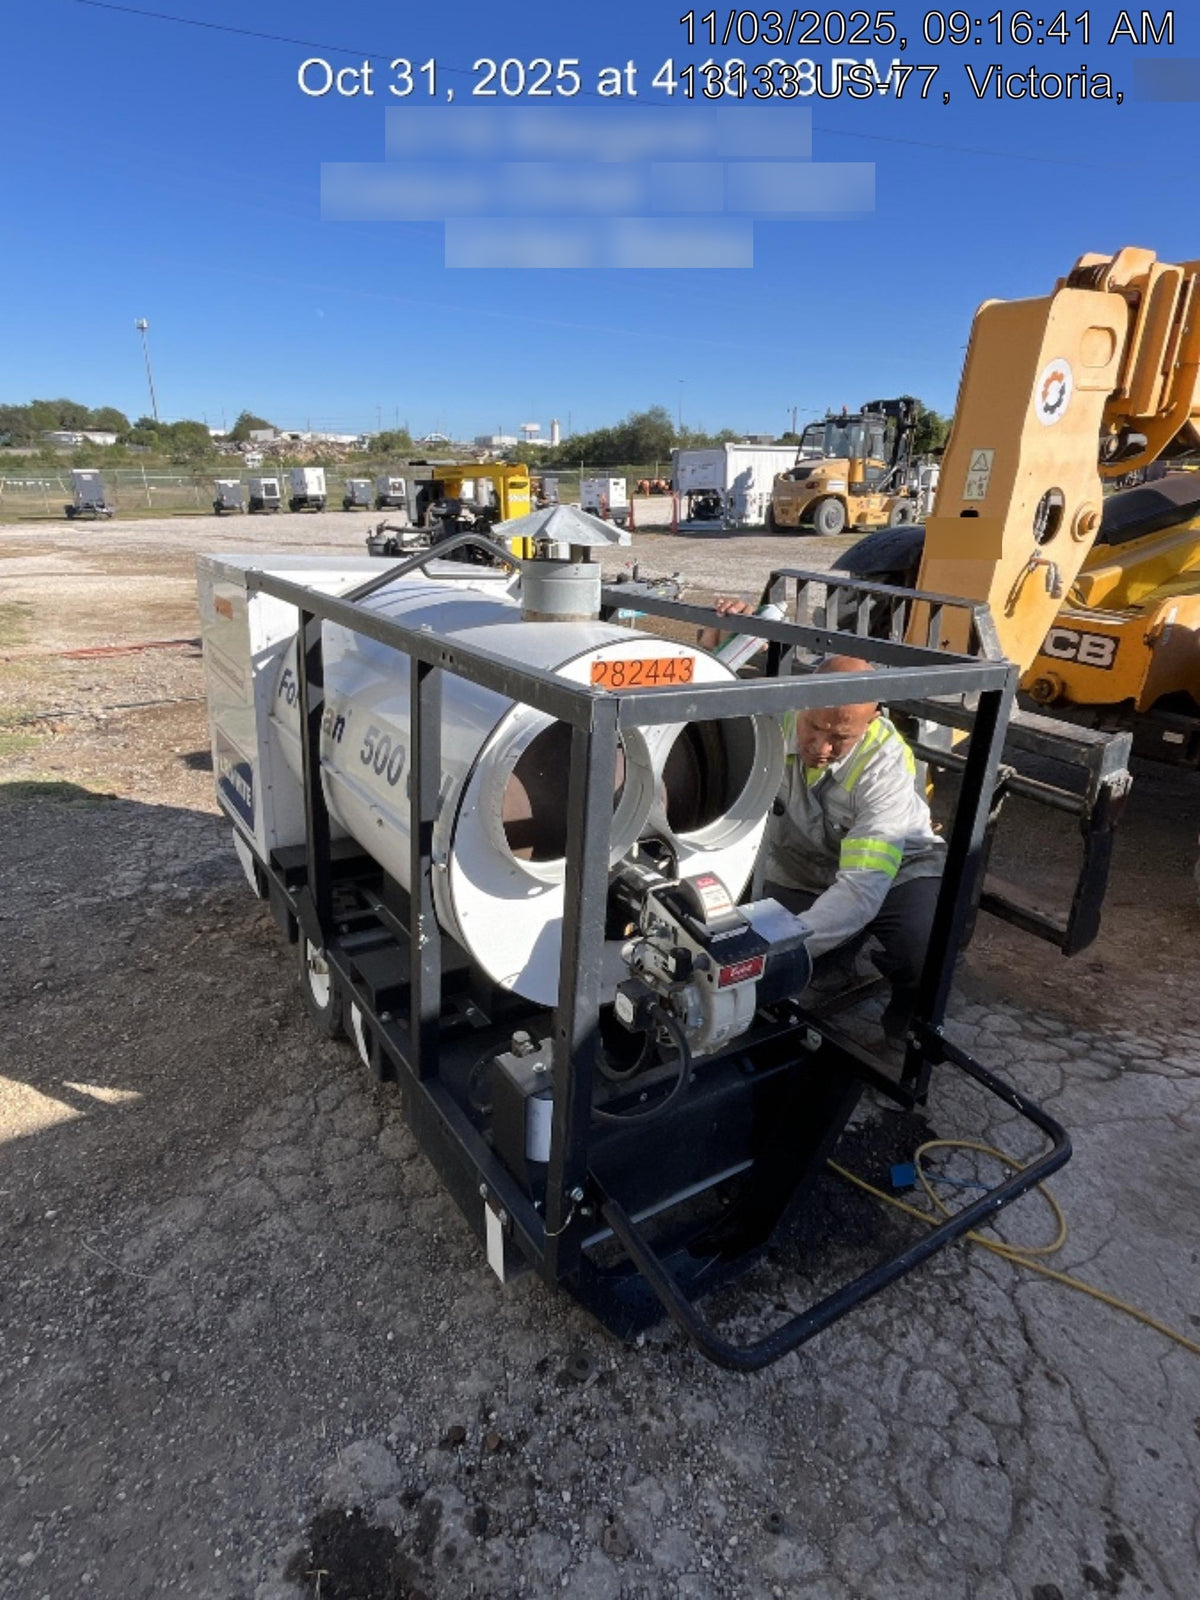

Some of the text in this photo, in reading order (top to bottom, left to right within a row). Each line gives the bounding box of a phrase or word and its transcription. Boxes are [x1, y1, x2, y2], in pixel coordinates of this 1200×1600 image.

[1042, 628, 1116, 667] CB
[592, 657, 693, 687] 282443
[278, 667, 346, 744] Foan
[360, 724, 406, 787] 500
